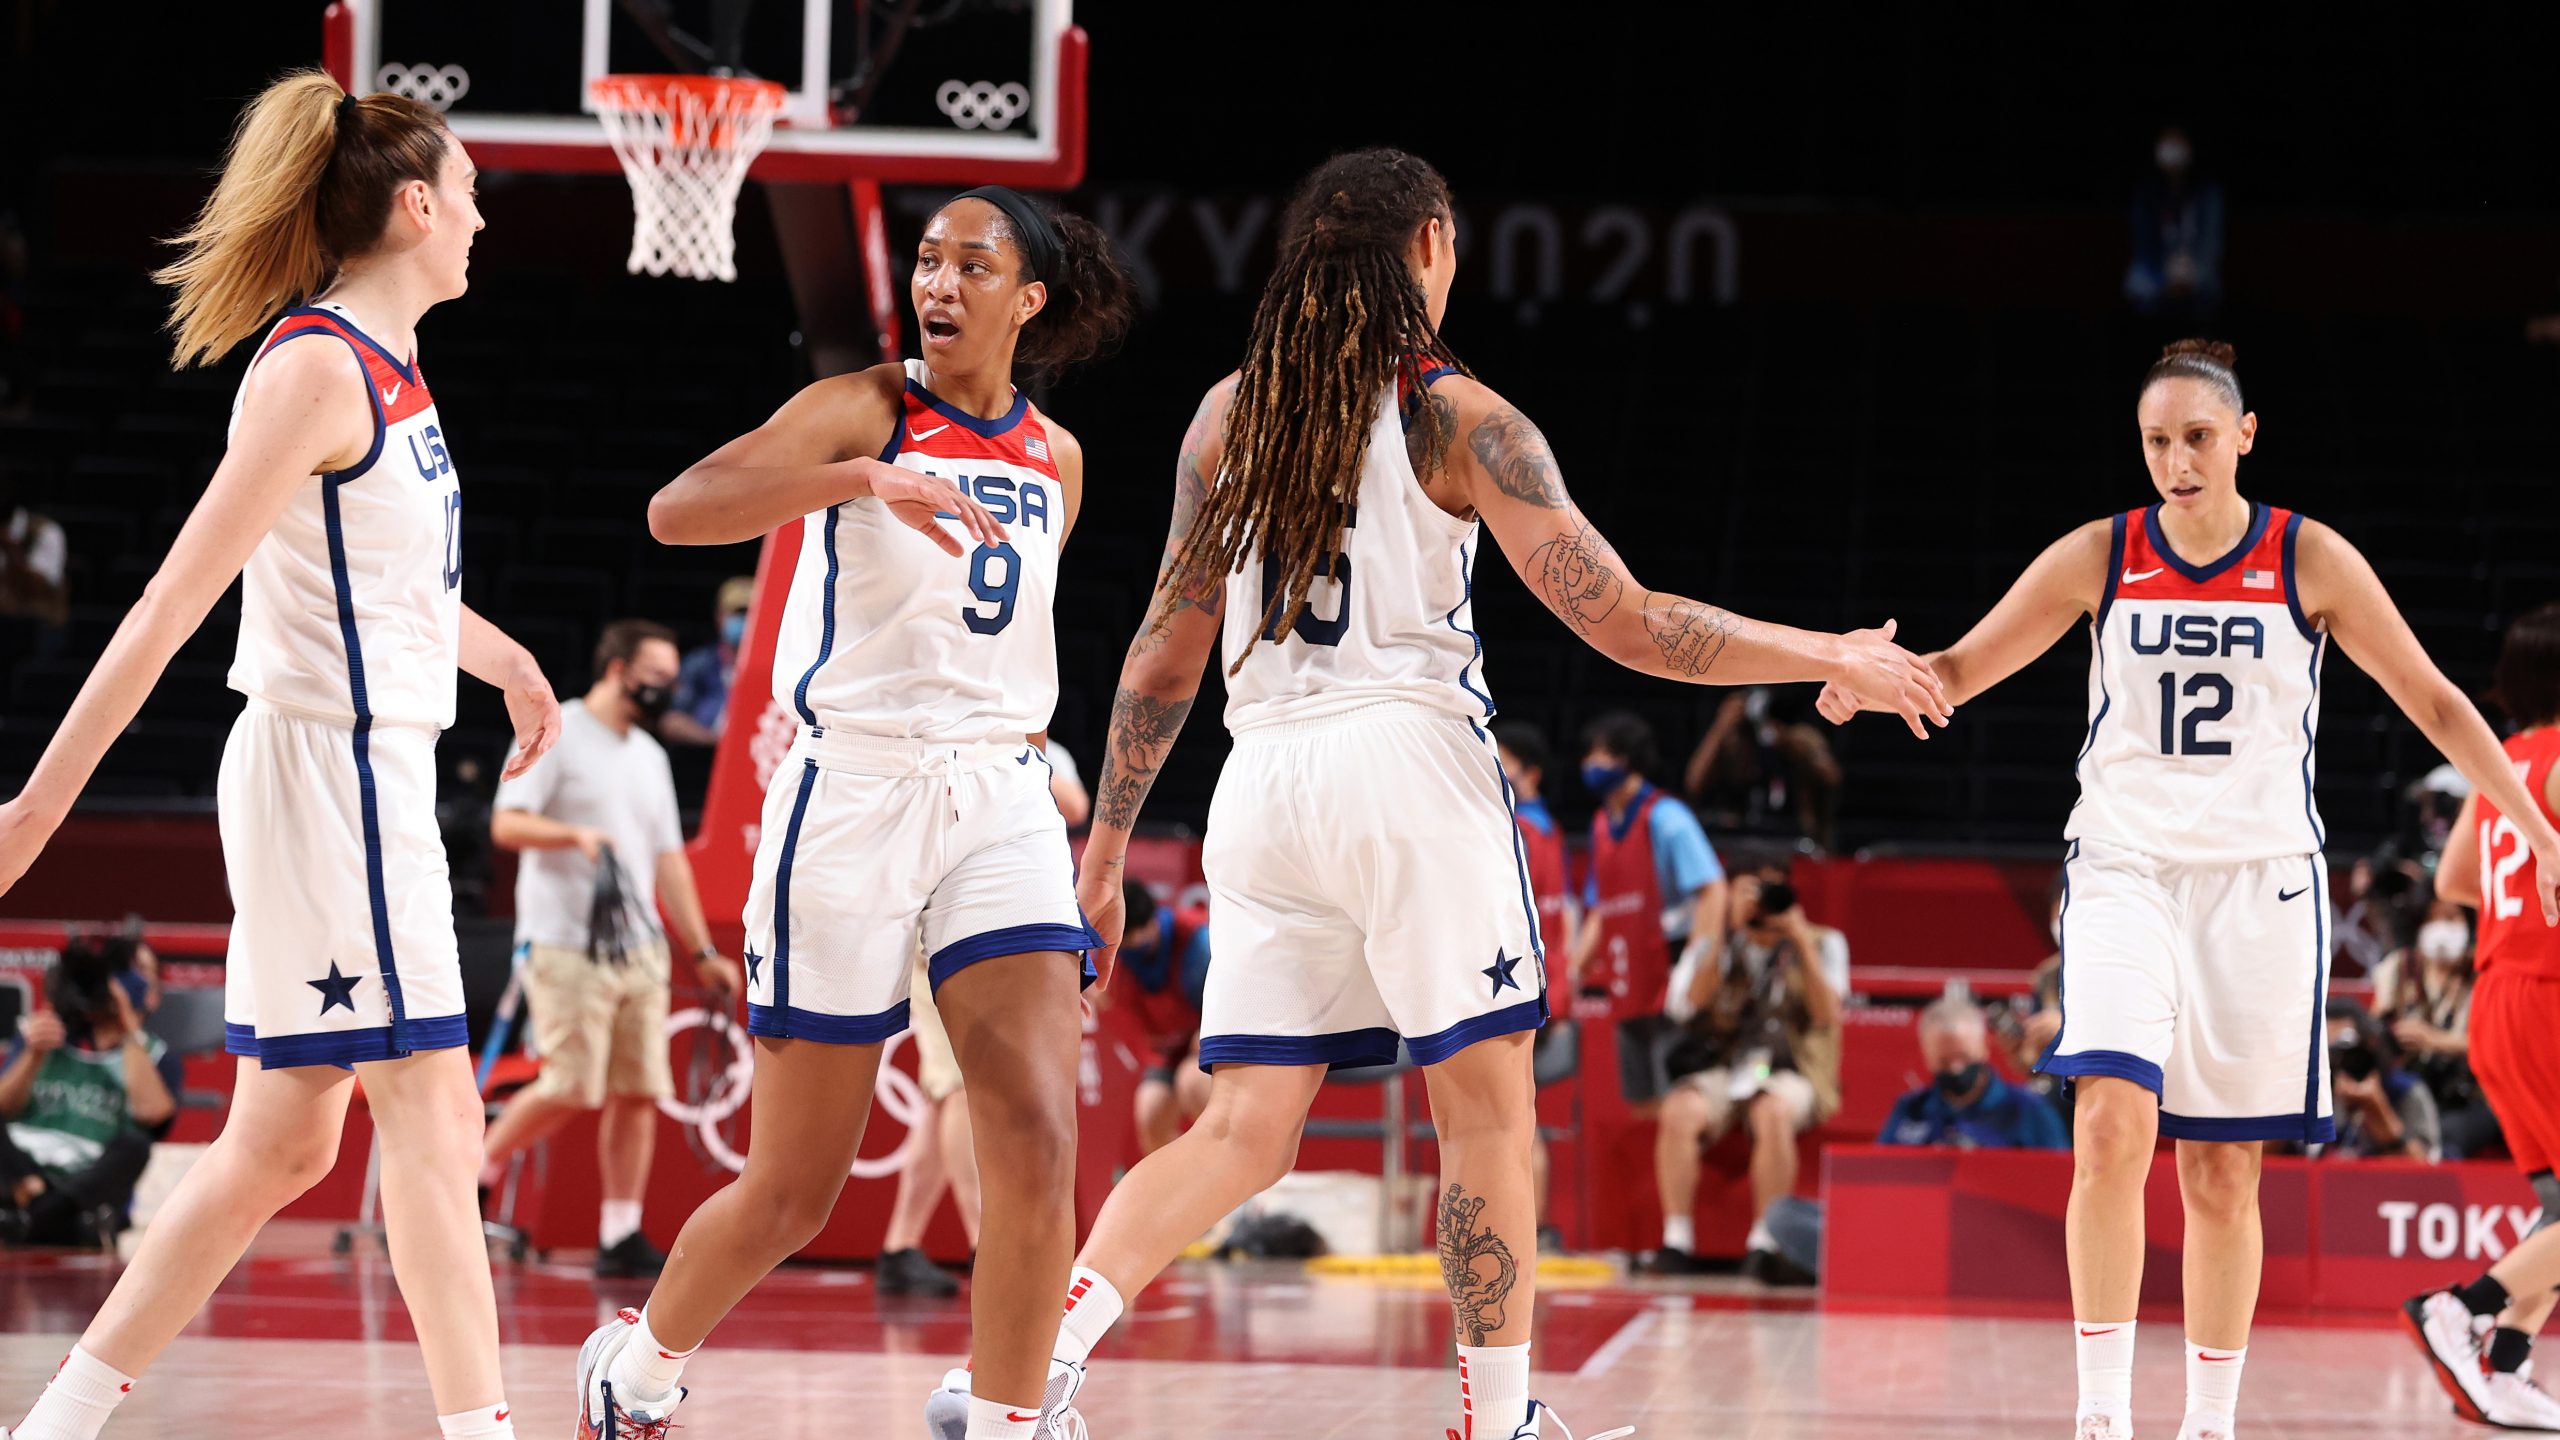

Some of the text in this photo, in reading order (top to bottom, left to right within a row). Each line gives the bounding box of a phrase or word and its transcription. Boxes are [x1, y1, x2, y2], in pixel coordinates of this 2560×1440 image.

[1455, 202, 1741, 330] 020
[408, 424, 455, 482] US
[963, 540, 1022, 636] 9
[2131, 613, 2264, 659] USA
[2158, 672, 2233, 756] 12
[2479, 814, 2531, 921] 12
[2377, 1200, 2544, 1261] TOKY
